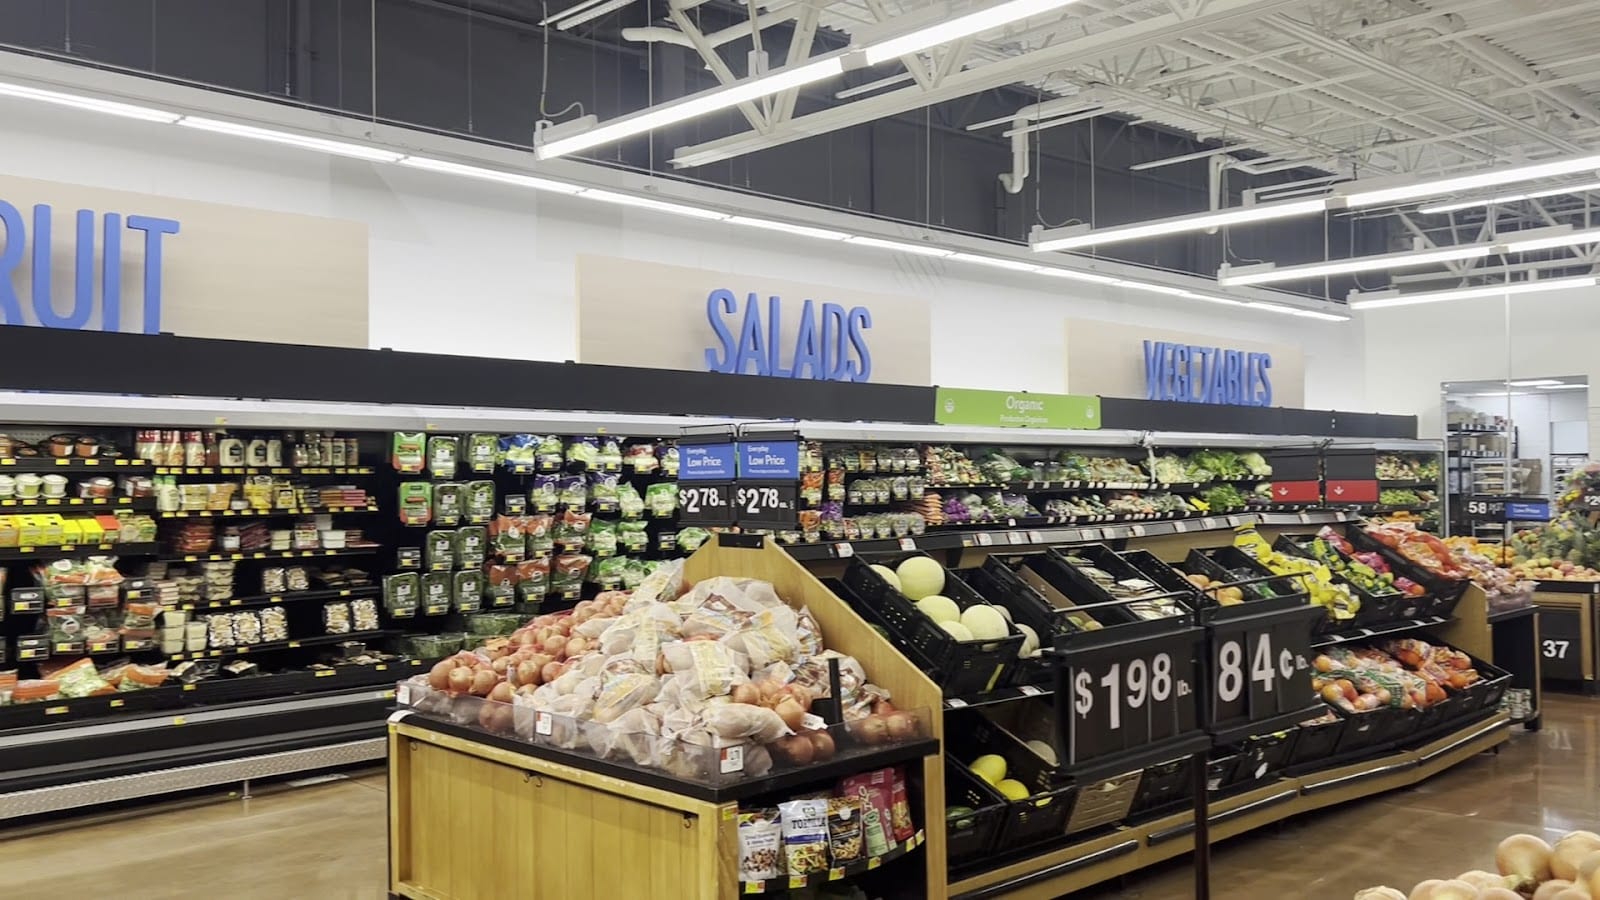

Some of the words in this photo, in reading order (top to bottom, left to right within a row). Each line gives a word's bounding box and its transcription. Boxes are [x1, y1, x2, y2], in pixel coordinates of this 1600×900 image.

[704, 288, 873, 383] SALADS
[1143, 340, 1273, 407] VEGETABLES
[1005, 395, 1044, 414] Organic
[703, 456, 721, 466] Price
[765, 454, 786, 465] Price
[1468, 501, 1487, 514] 58
[1542, 639, 1570, 659] 37
[1177, 680, 1192, 697] lb.
